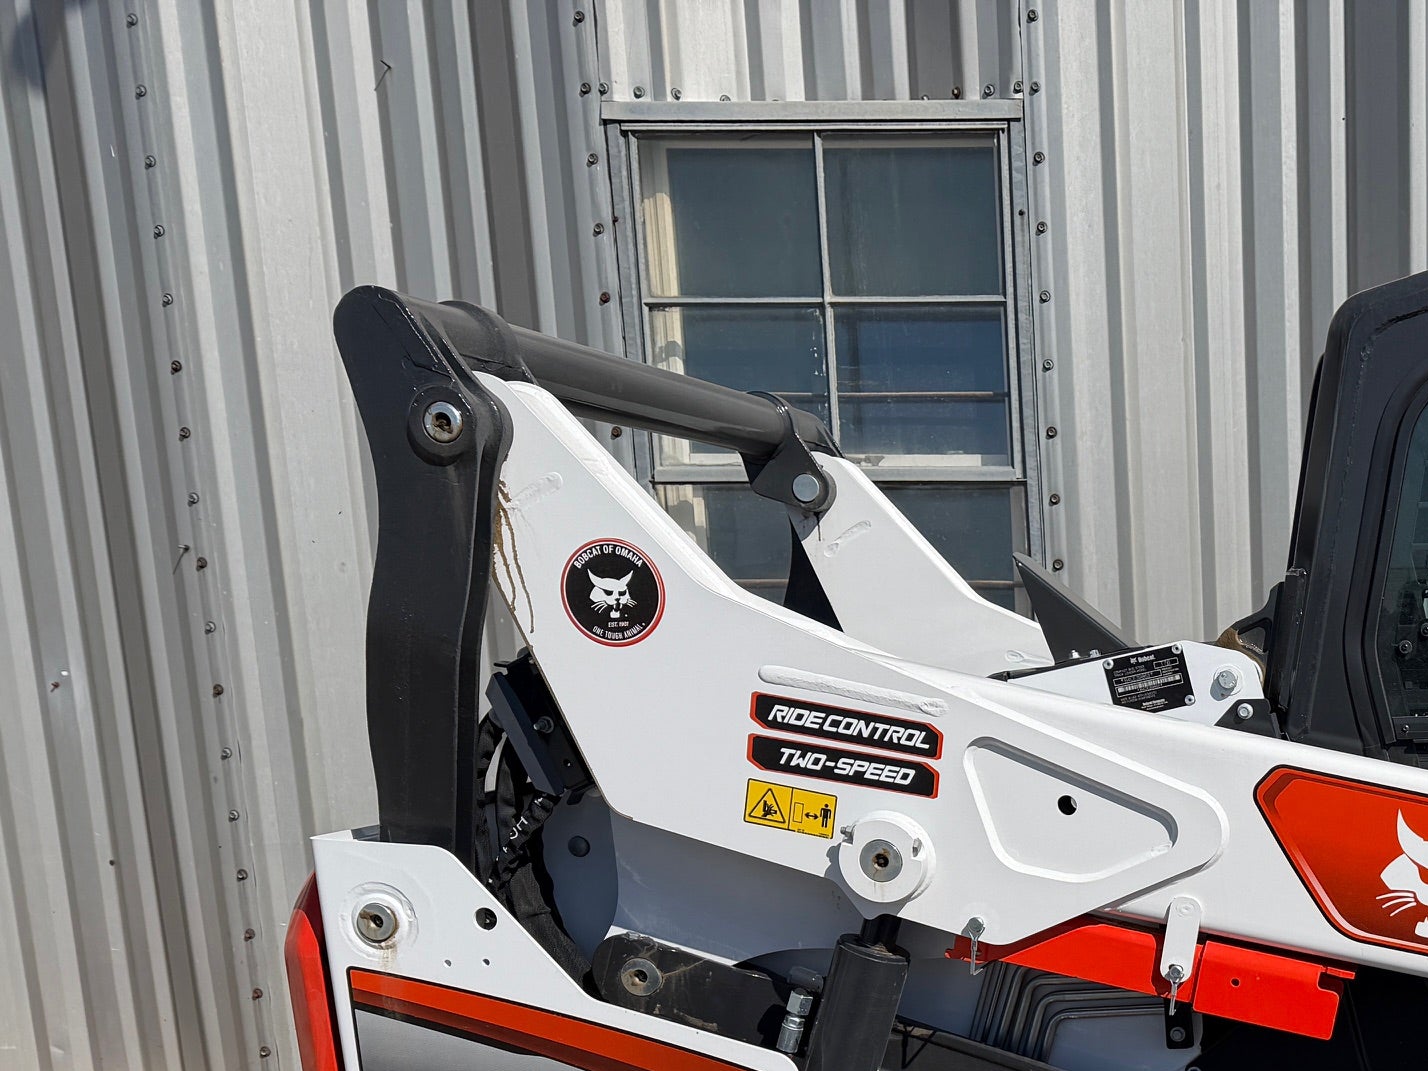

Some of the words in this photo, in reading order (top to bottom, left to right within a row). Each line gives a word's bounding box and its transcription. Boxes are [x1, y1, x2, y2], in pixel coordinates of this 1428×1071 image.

[573, 545, 601, 569] BOBCAT
[602, 544, 614, 554] OF
[615, 545, 643, 568] OMAHA
[592, 625, 604, 637] ONE
[604, 631, 624, 640] TOUGH
[767, 704, 826, 730] RIDE
[822, 714, 930, 750] CONTROL
[779, 747, 916, 786] TWO-SPEED
